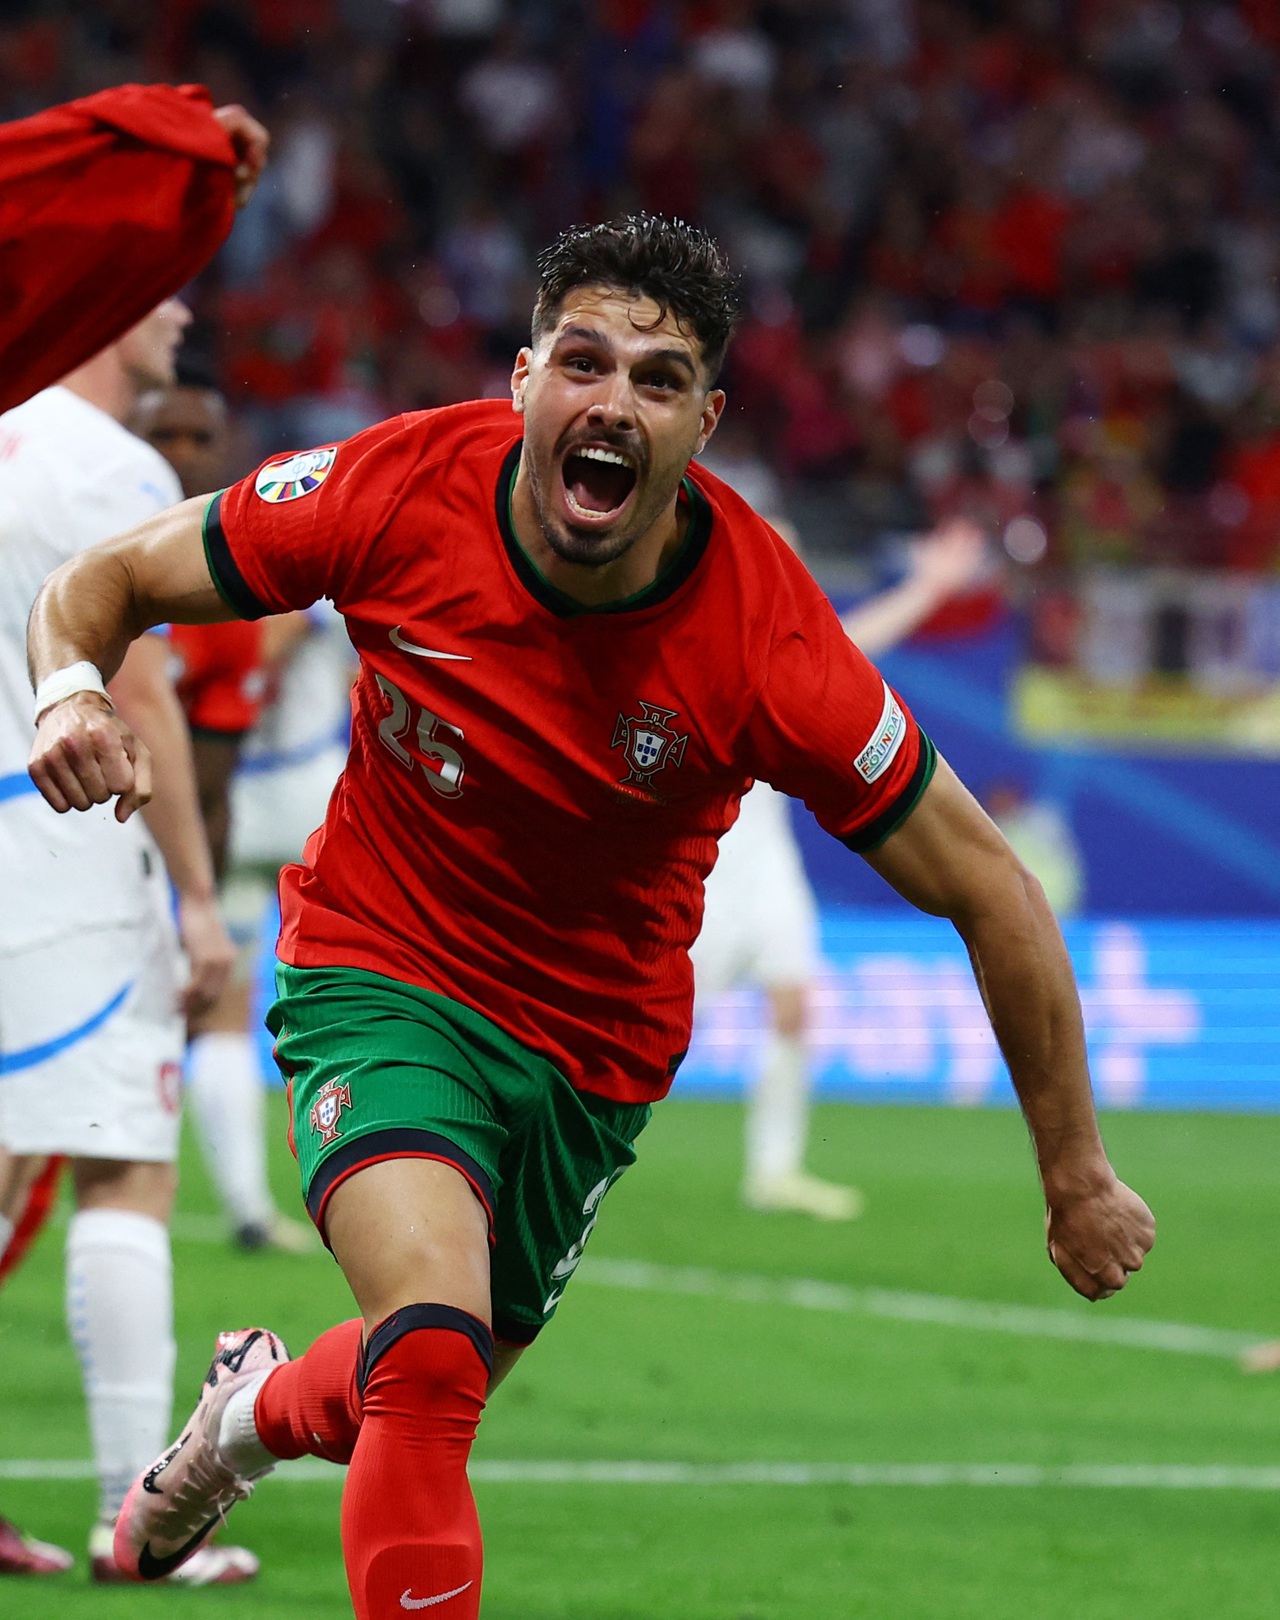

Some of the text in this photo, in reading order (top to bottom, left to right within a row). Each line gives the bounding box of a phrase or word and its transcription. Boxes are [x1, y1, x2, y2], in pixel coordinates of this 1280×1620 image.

[375, 673, 465, 799] 25
[857, 745, 875, 767] UEFA
[861, 697, 900, 776] FOUNDAT
